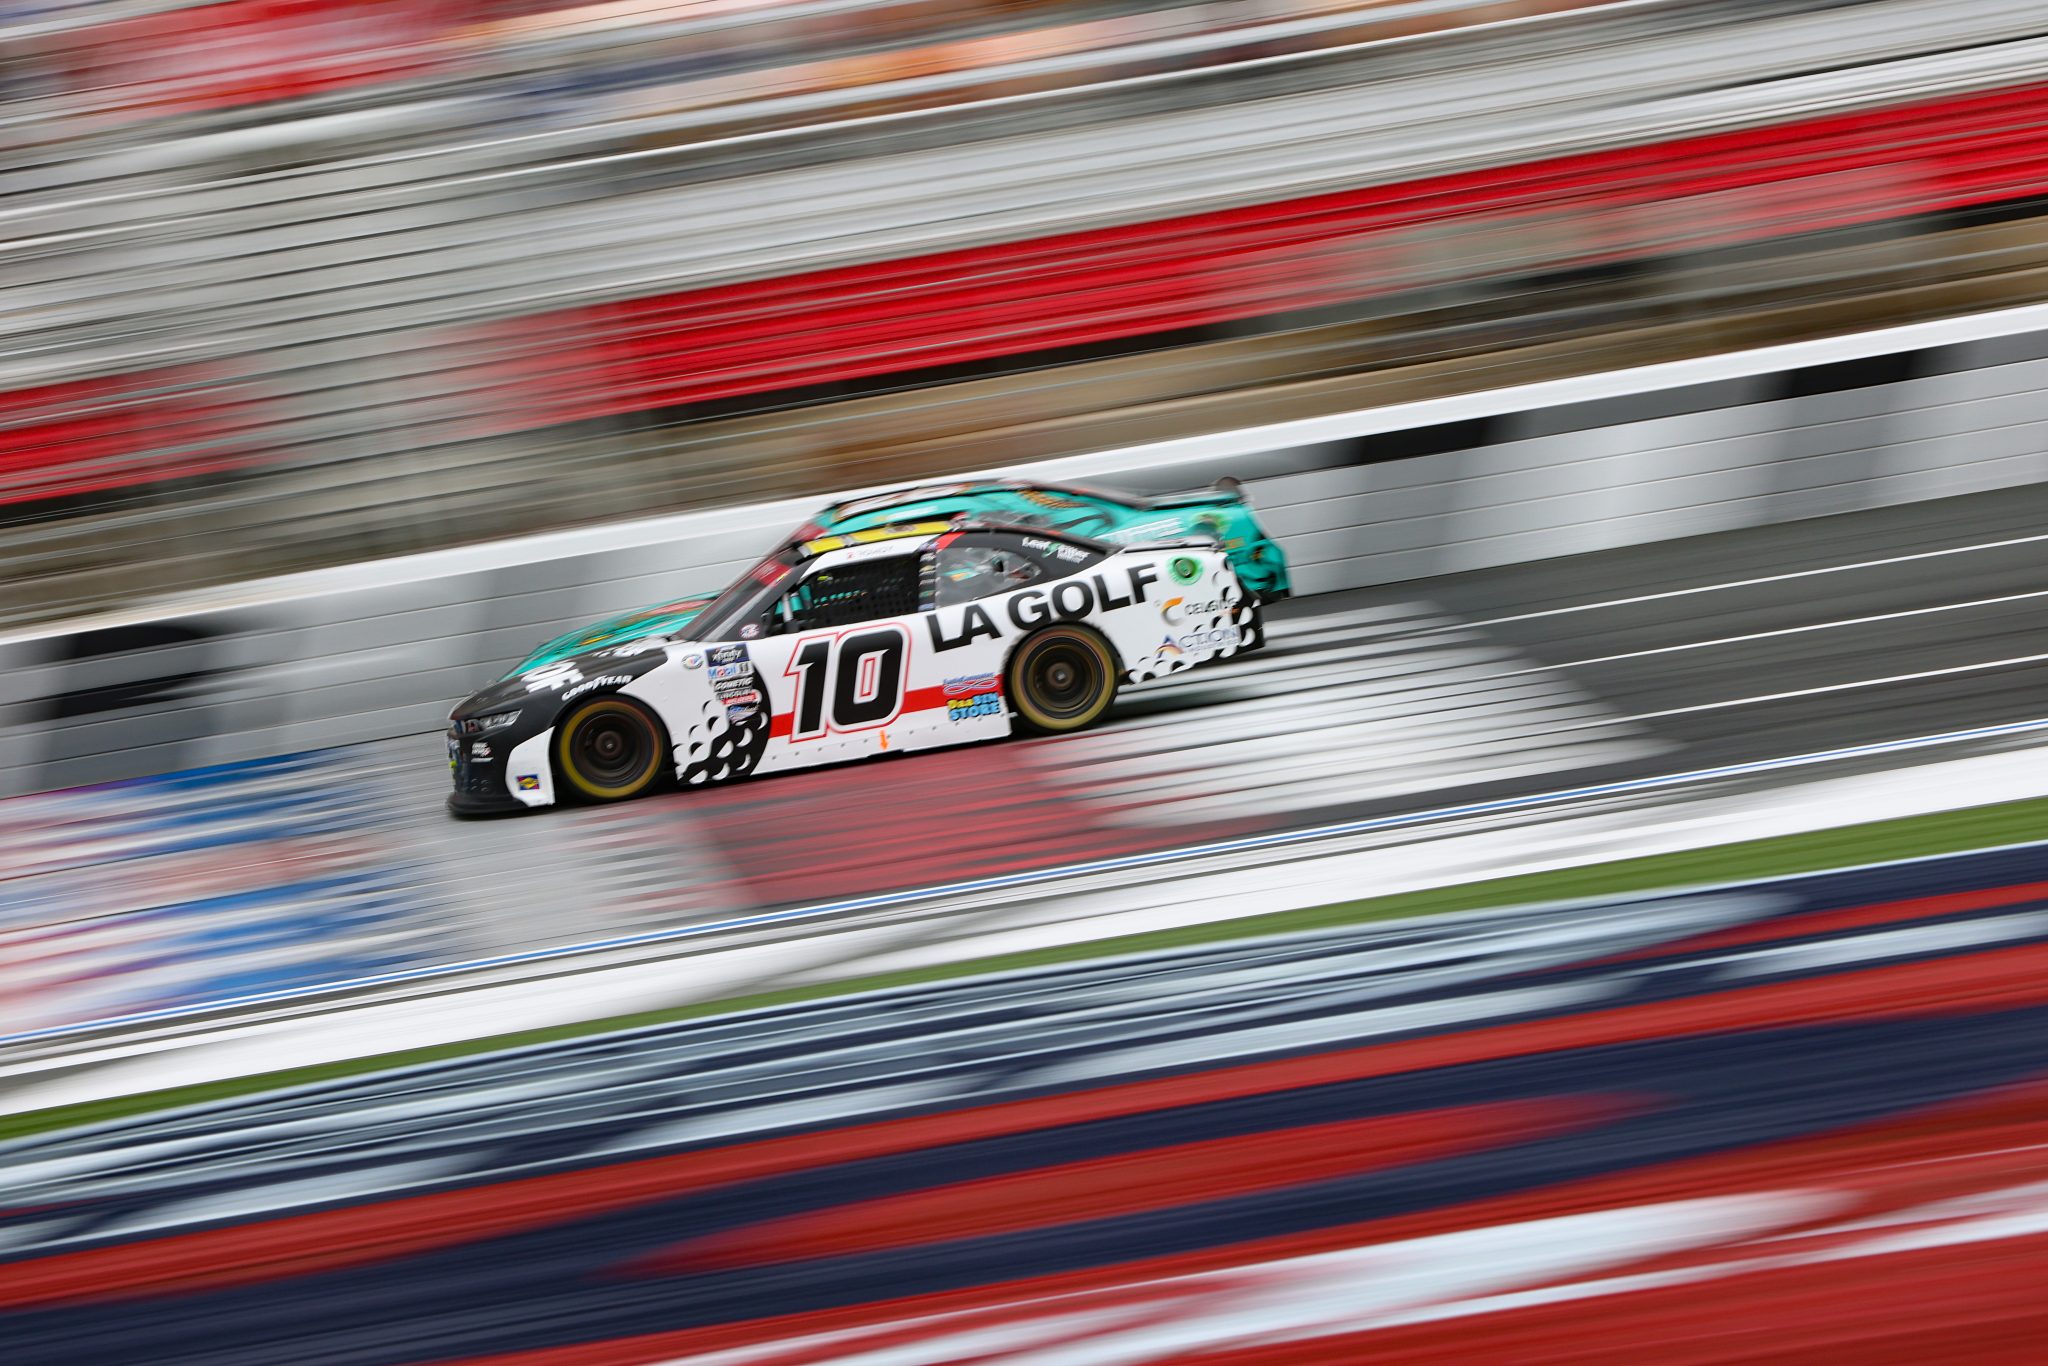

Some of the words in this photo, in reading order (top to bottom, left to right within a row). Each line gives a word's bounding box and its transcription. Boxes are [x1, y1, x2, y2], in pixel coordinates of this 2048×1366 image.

[926, 604, 1001, 653] LA
[1007, 562, 1160, 631] GOLF
[792, 626, 908, 737] 10
[949, 702, 1000, 721] STORE
